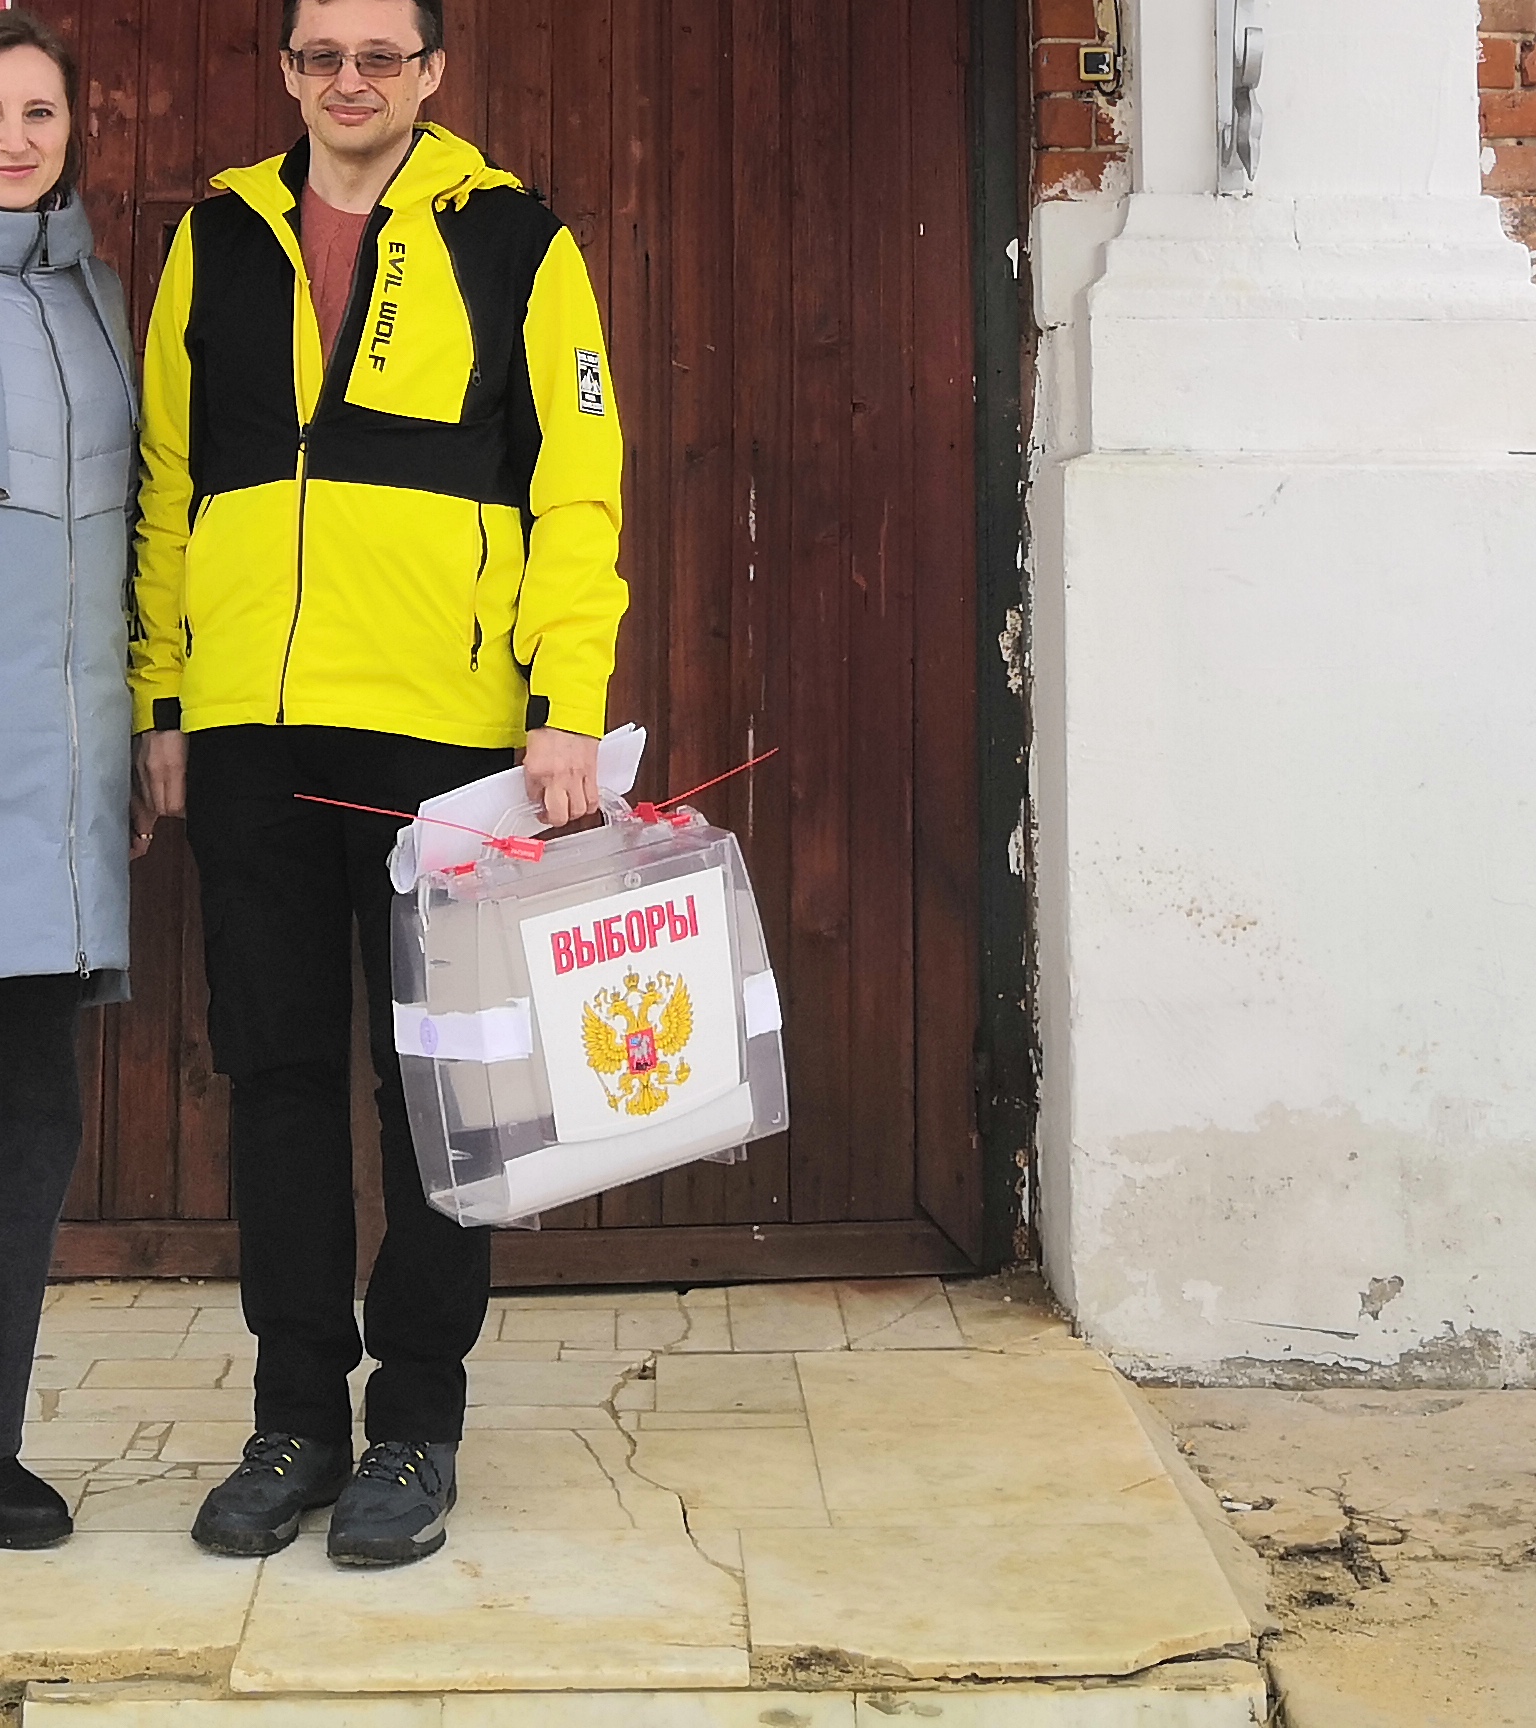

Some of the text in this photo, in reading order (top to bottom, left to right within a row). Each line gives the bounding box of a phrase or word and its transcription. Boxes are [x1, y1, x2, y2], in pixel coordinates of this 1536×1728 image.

[368, 241, 406, 373] EVIL WOLF
[550, 894, 699, 976] ВЫБОРЫ
